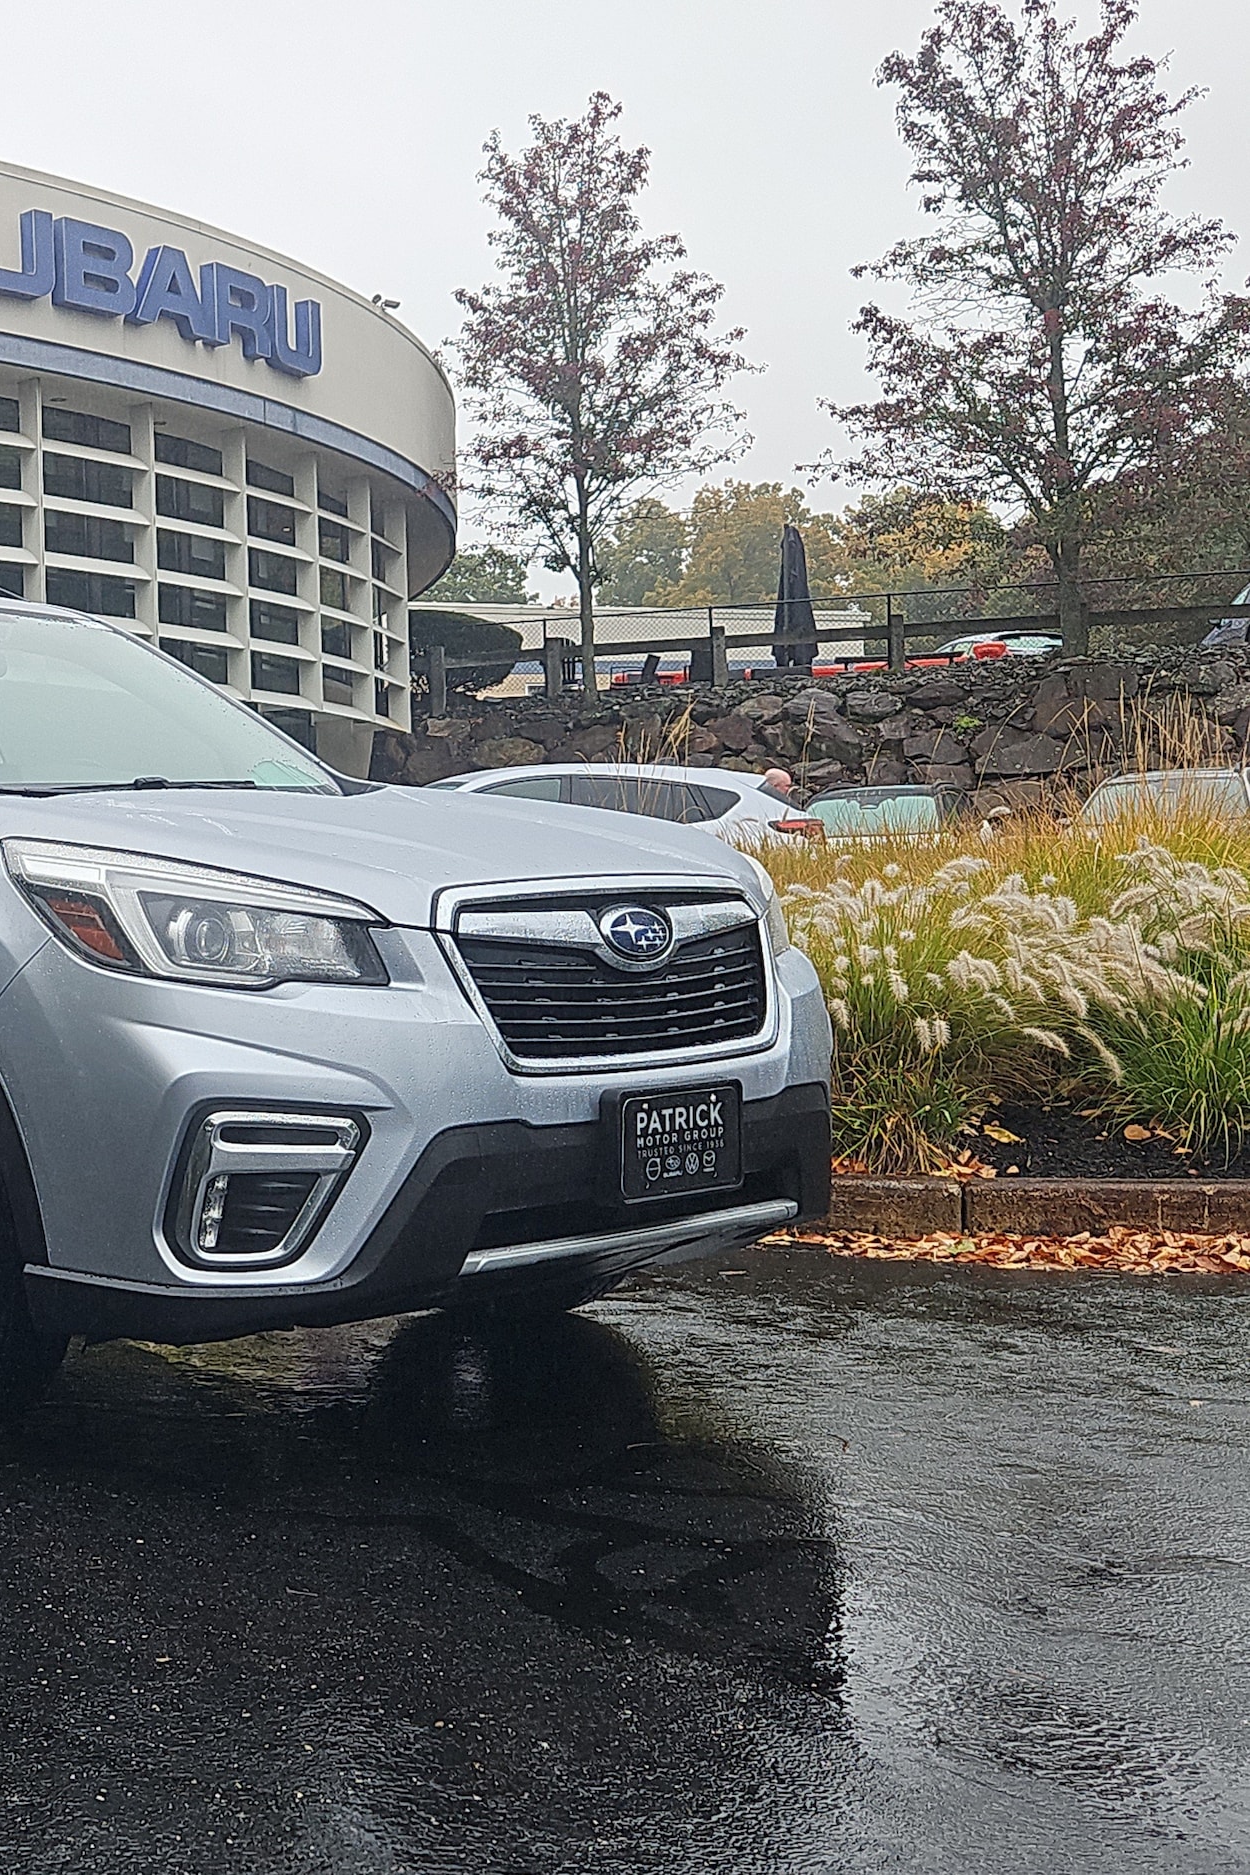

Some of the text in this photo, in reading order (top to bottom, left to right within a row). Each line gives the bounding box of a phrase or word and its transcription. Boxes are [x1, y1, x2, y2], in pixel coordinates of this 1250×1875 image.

[636, 1102, 723, 1135] PATRICK
[636, 1126, 724, 1148] MOTOR GROUP
[637, 1147, 675, 1159] TRUSTED
[678, 1141, 702, 1153] SINCE
